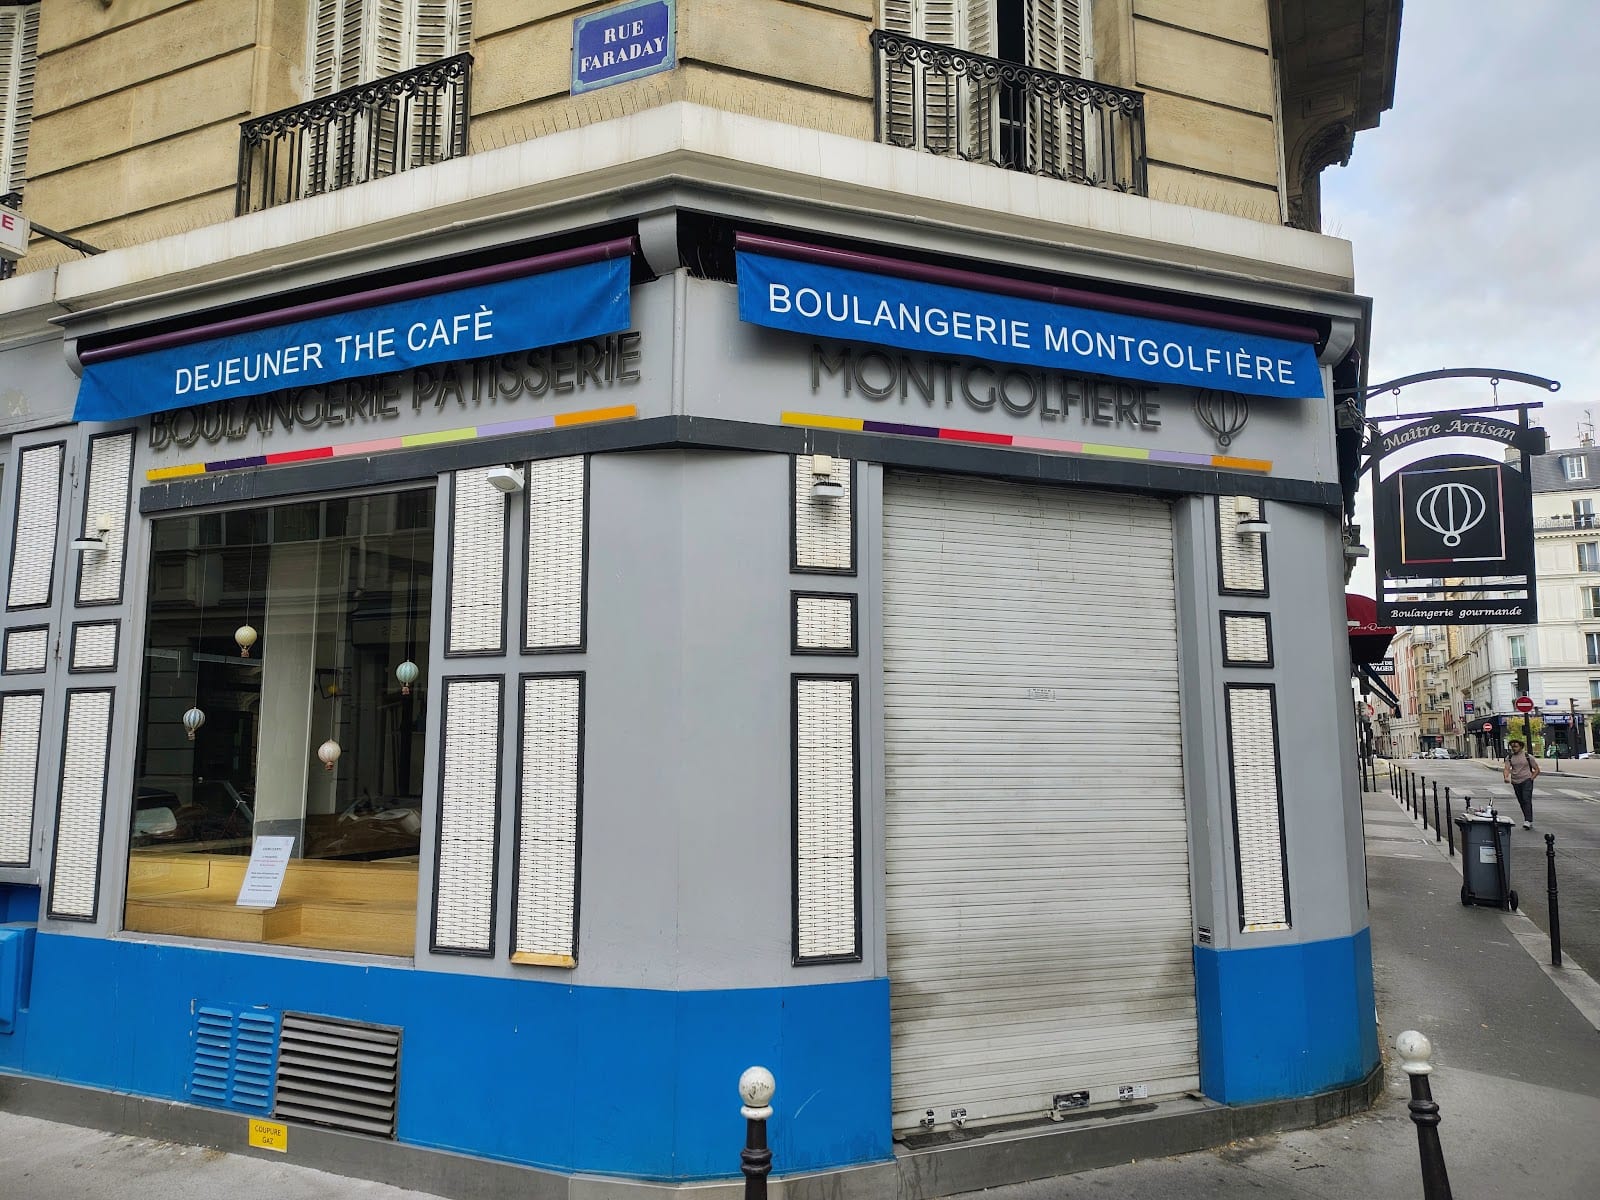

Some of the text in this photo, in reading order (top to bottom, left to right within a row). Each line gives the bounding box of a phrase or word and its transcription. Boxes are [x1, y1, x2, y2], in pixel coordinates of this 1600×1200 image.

[603, 20, 644, 45] RUE
[580, 36, 665, 73] FARADAY
[175, 304, 493, 396] DEJEUNER THE CAFÈ
[769, 282, 1296, 386] BOULANGERIE MONTGOLFIÈRE
[149, 374, 401, 450] BOULANGERIE
[1383, 419, 1516, 452] Maître Artisan
[1390, 606, 1522, 620] Boulangerie gourmande
[254, 1124, 282, 1137] COUPURE
[262, 1136, 274, 1145] GAZ
